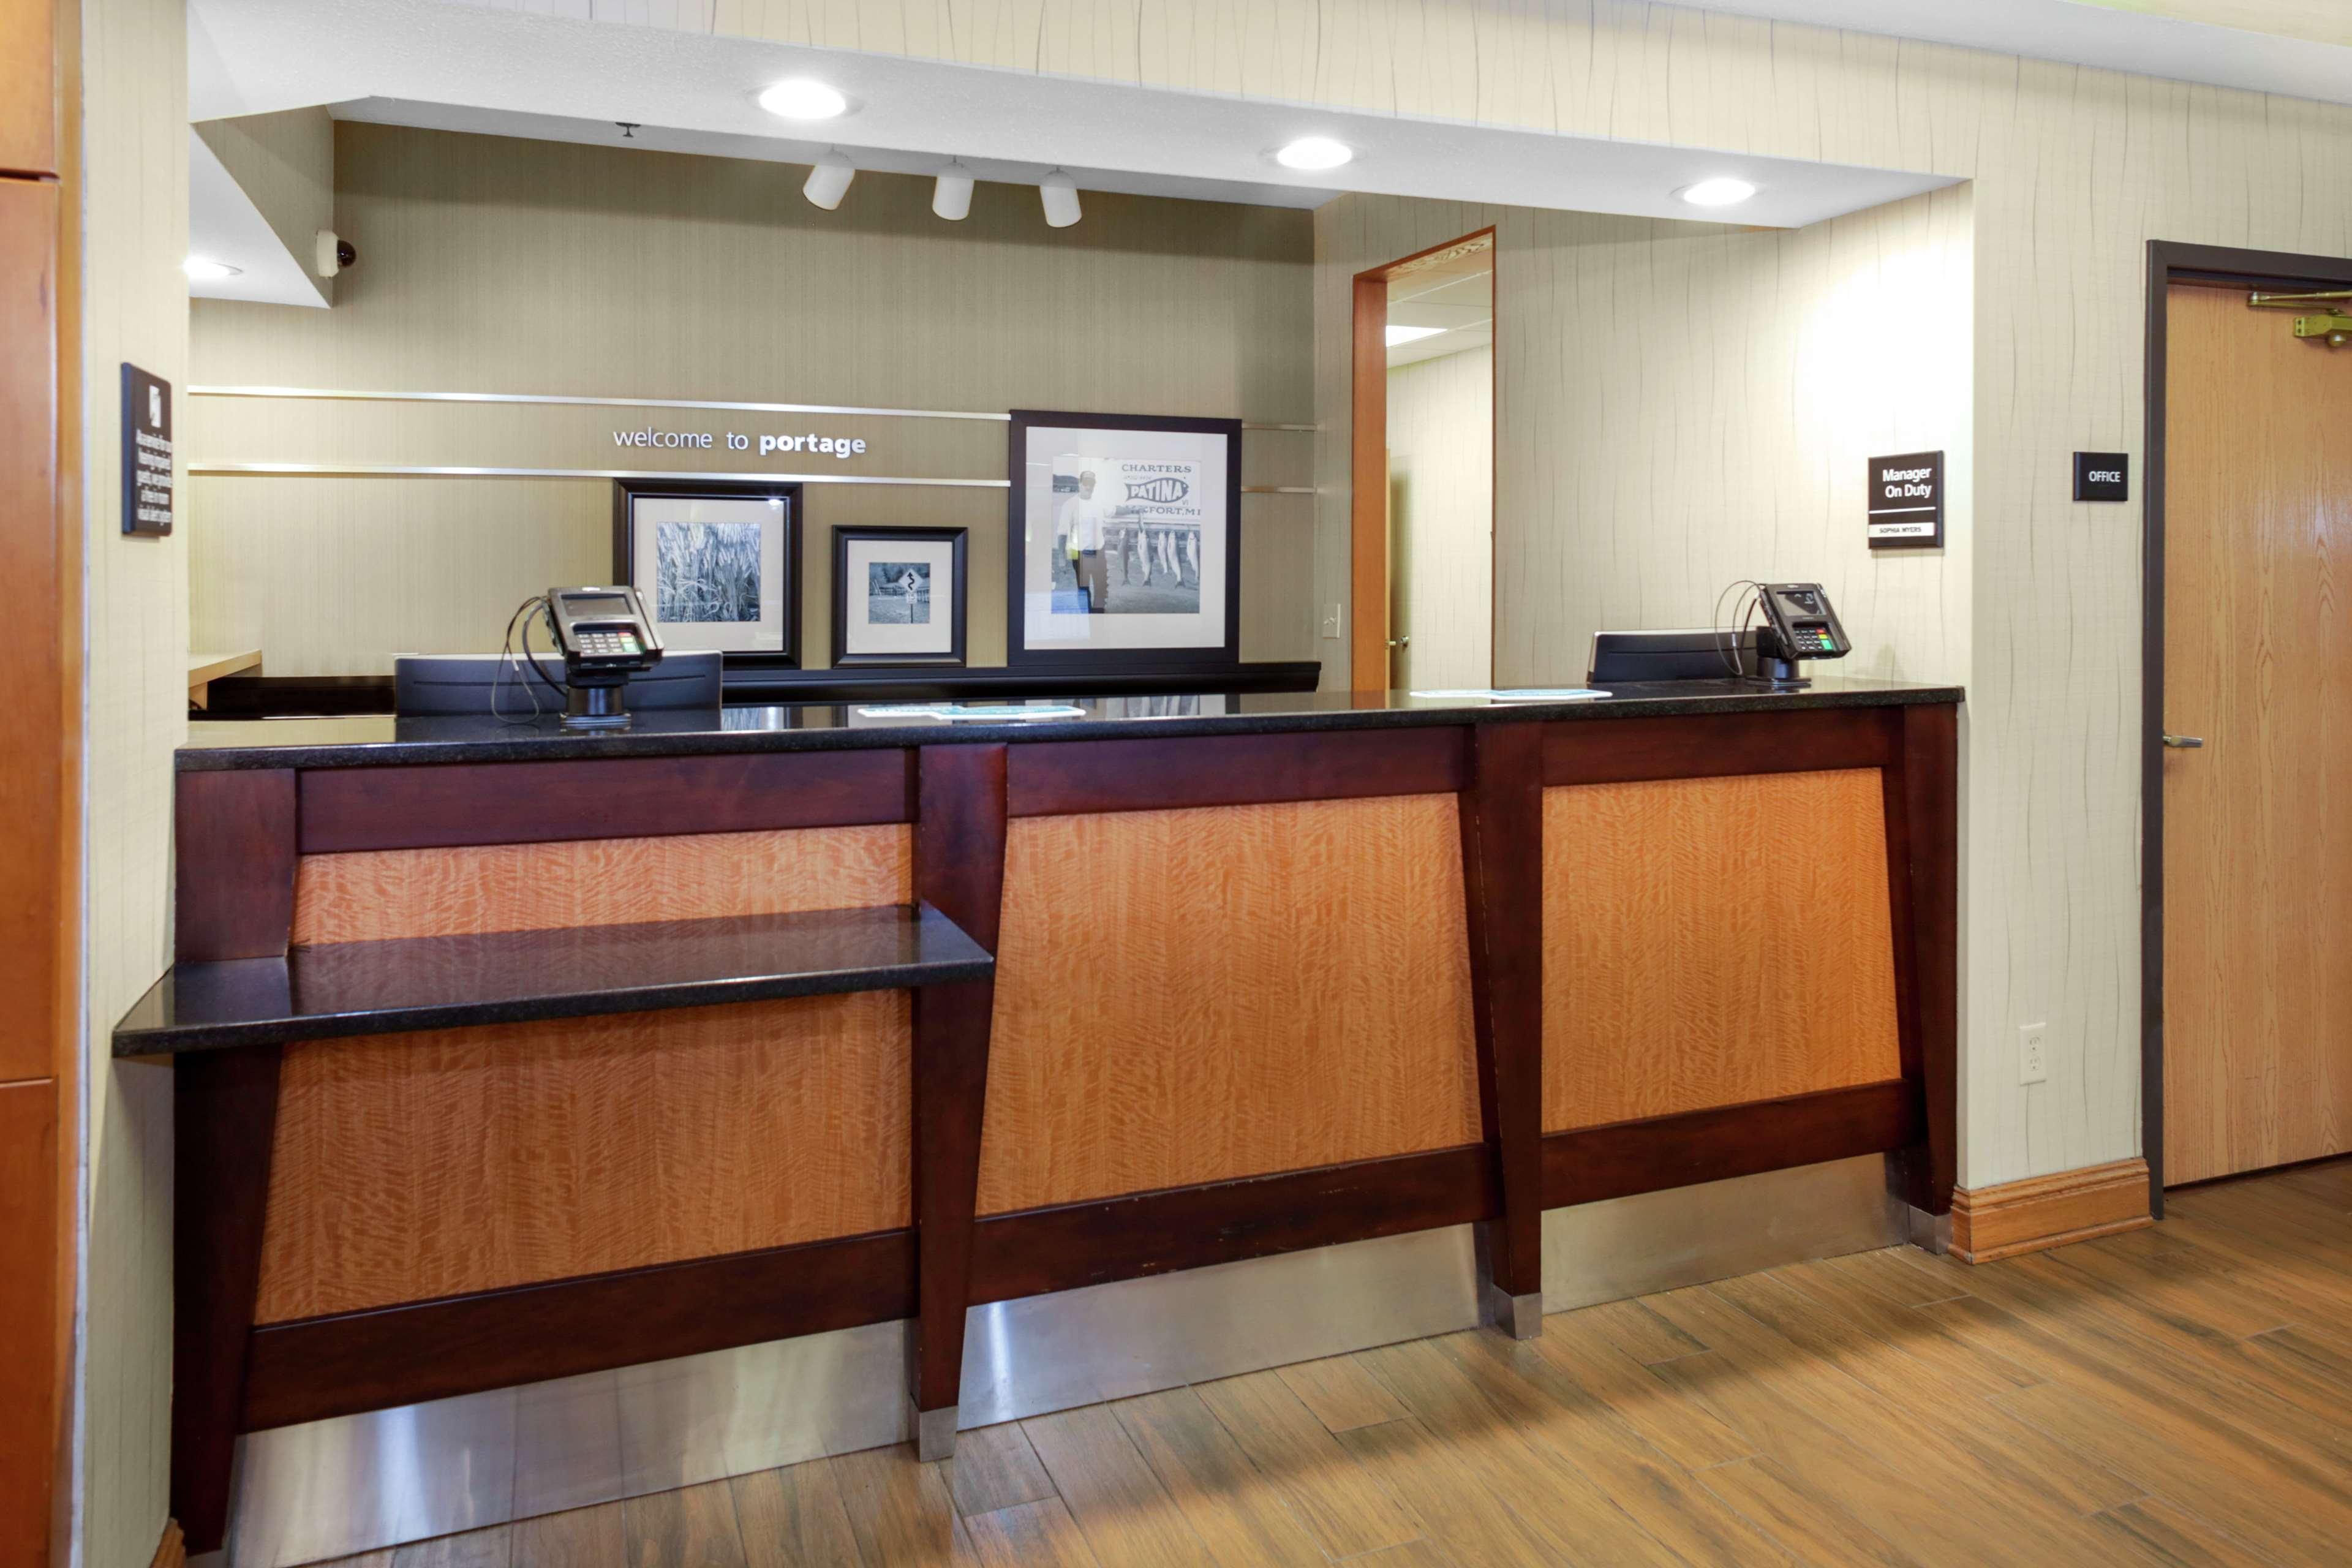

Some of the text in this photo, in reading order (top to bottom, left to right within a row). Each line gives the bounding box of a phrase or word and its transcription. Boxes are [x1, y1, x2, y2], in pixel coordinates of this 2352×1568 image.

[613, 427, 866, 459] welcome to portage
[1121, 464, 1191, 473] CHARTERS
[1883, 467, 1932, 482] Manager
[2088, 470, 2121, 483] OFFICE
[1131, 480, 1183, 502] PATINA
[1885, 483, 1932, 499] On Duty
